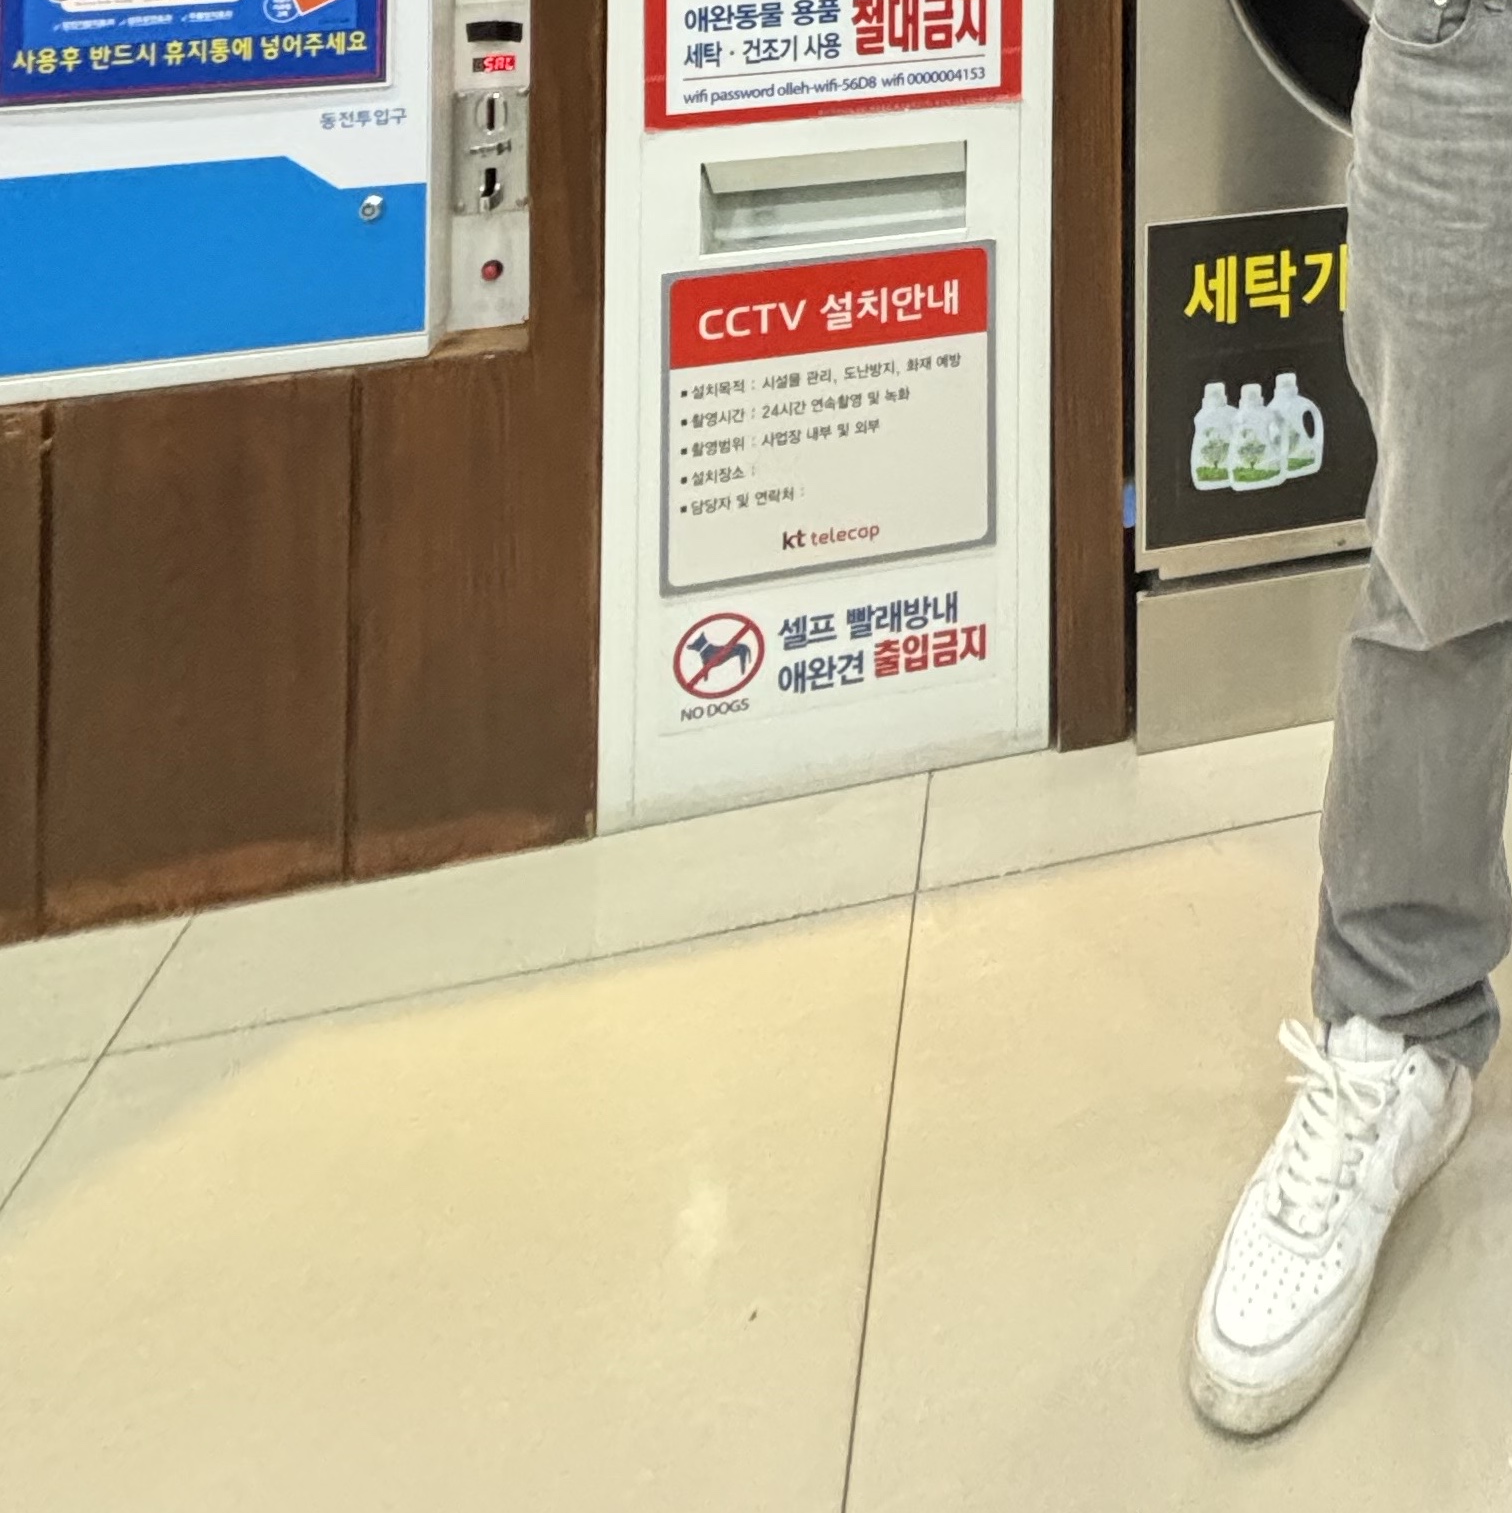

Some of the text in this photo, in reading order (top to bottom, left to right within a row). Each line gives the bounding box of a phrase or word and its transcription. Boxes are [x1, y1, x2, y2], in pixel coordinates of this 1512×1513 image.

[684, 1, 784, 33] 애완동물
[12, 31, 368, 76] 사용후 반드시 휴지통에 넣어주세요
[684, 32, 841, 69] 세탁 건조기 사용
[684, 87, 708, 104] wifi
[711, 82, 774, 106] password
[881, 72, 905, 88] wifi
[320, 107, 407, 131] 동전투입구
[1184, 243, 1347, 324] 세탁기
[698, 279, 959, 341] CCTV 설치안내
[691, 352, 961, 400] 설치목적 시설물 관리, 도난방지, 화재 예방
[691, 385, 911, 429] 촬영시간 24시간 연속촬영 녹화
[691, 418, 881, 458] 촬영범위 사업장 내부 외부
[691, 466, 745, 486] 설치장소
[691, 486, 795, 516] 담당자 연락처
[782, 523, 880, 551] kt telecop
[777, 591, 959, 651] 셀프 빨래방내
[777, 623, 987, 694] 애완견 출입금지
[681, 698, 750, 722] NO DOGS
